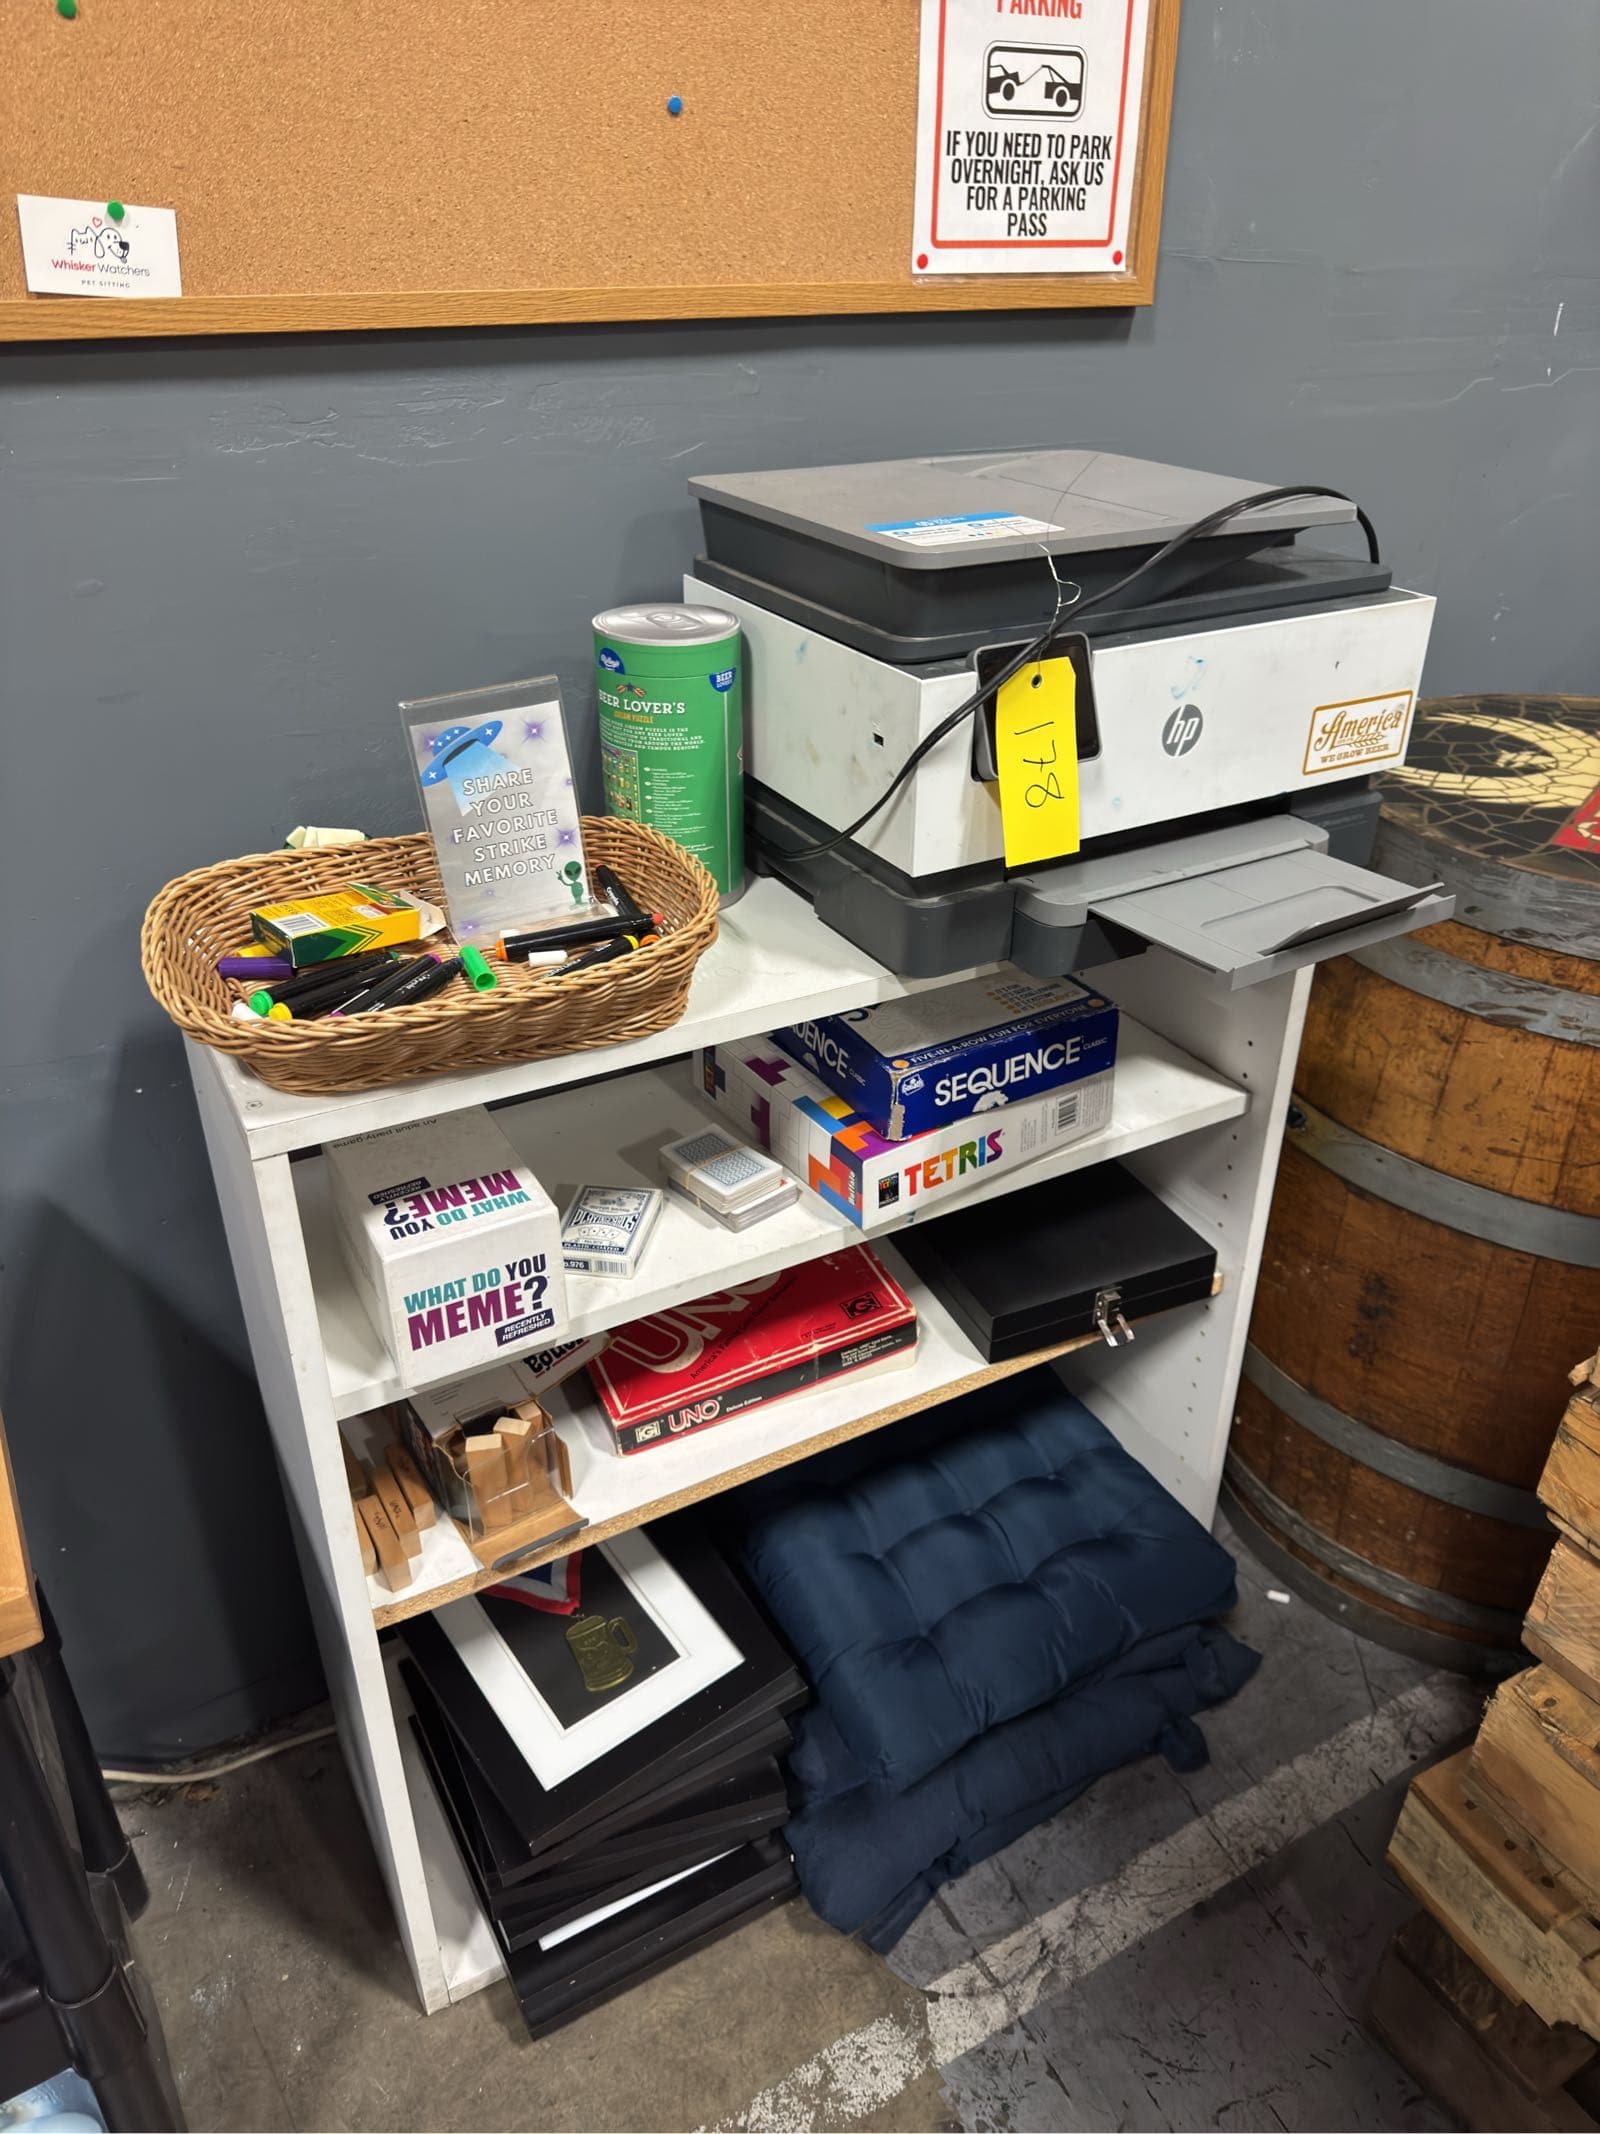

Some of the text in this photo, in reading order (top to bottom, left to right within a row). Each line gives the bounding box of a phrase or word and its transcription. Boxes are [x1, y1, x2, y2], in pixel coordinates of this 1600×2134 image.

[946, 130, 1113, 160] IF YOU NEED TO PARK
[1049, 161, 1080, 186] ASK
[1084, 162, 1104, 186] US
[967, 186, 1086, 211] FOR A PARKING
[1007, 212, 1048, 237] PASS
[52, 258, 151, 277] Whisker Watchers
[623, 698, 686, 714] LOVER'S
[1165, 704, 1202, 757] hp
[1313, 709, 1403, 752] America
[1014, 721, 1066, 808] 178
[1337, 748, 1364, 760] GROW
[462, 768, 534, 796] SHARE
[469, 792, 534, 817] YOUR
[452, 809, 559, 845] FAVORITE
[473, 834, 547, 863] STRIKE
[464, 854, 556, 888] MEMORY
[793, 1021, 849, 1079] UENCE
[909, 1003, 1088, 1064] FIVE-IN-A-ROW FUN FOR EVERYONE
[934, 1036, 1081, 1107] SEQUENCE
[904, 1129, 1003, 1196] TETRIS
[383, 1168, 523, 1226] MEME?
[389, 1190, 532, 1241] WHAT DO YOU
[403, 1253, 547, 1314] WHAT DO YOU
[408, 1275, 548, 1351] MEME?
[502, 1318, 551, 1342] REFRESHED
[504, 1312, 546, 1334] RECENTLY
[668, 1399, 720, 1433] UNO
